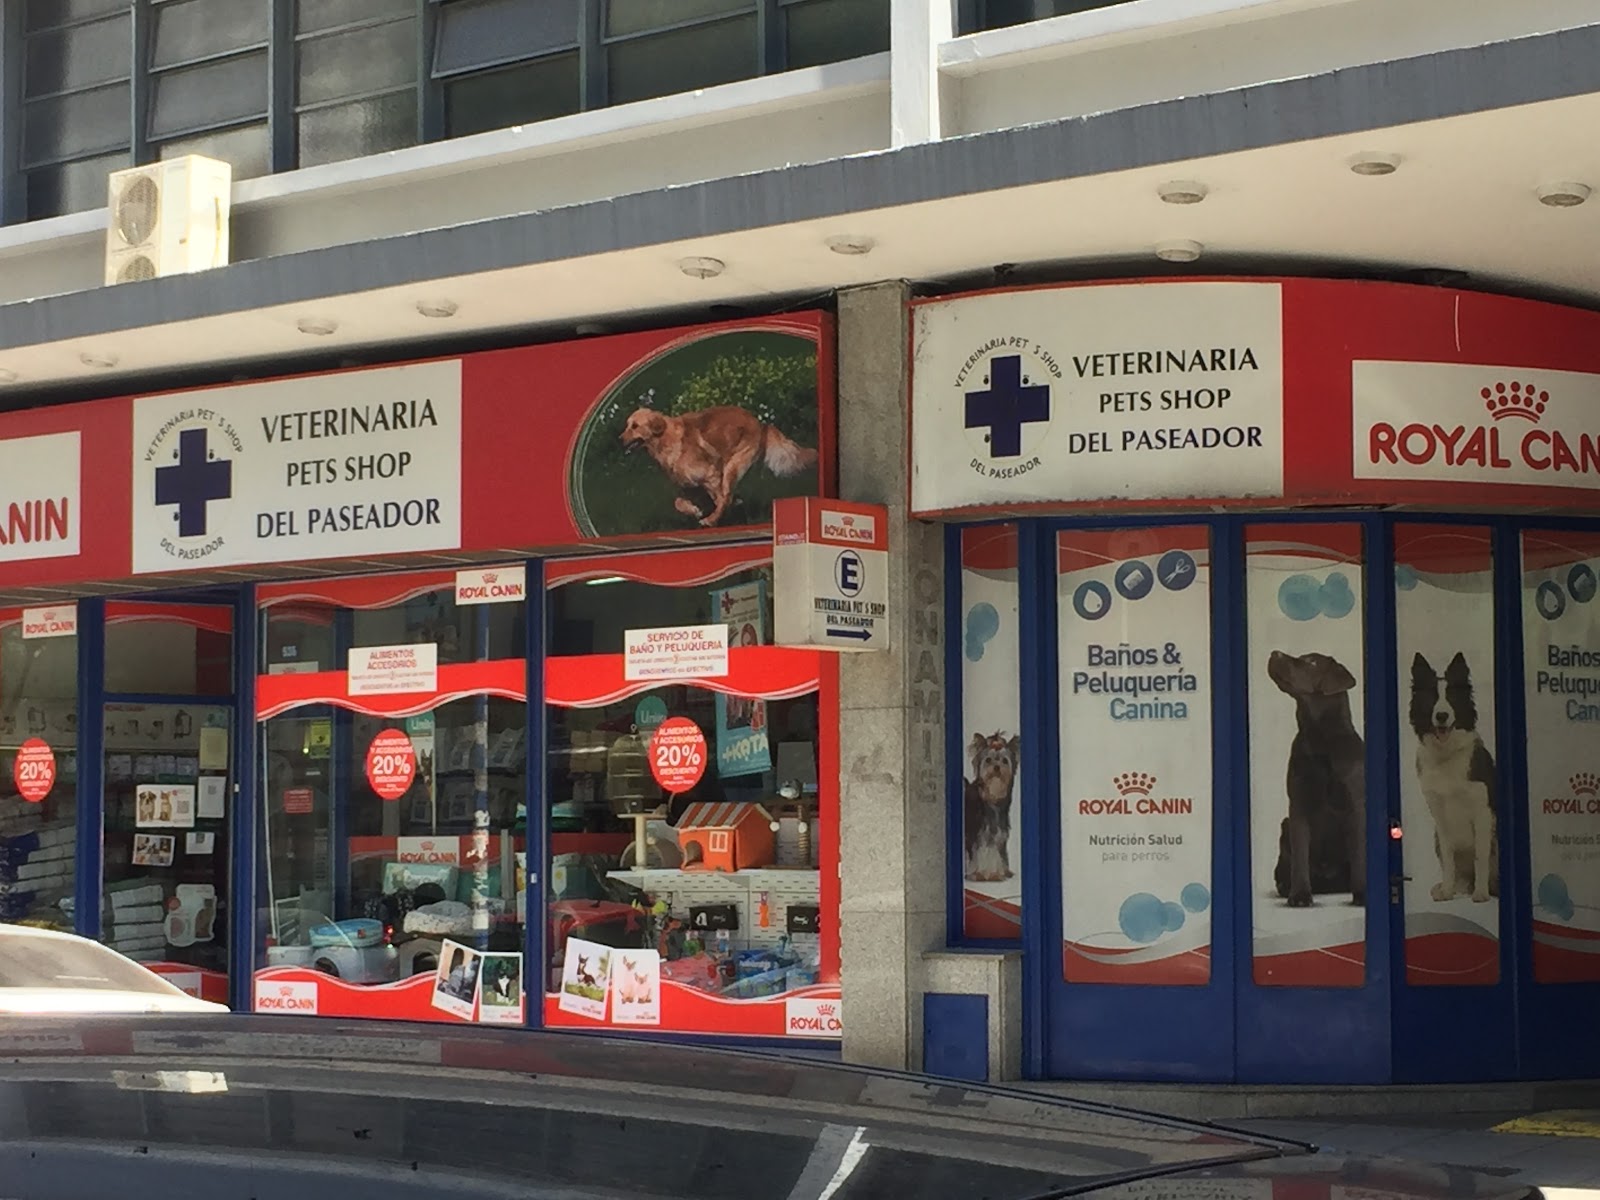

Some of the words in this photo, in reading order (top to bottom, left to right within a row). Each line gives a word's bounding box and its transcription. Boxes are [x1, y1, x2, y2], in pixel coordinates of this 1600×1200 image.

[954, 337, 1006, 388] VETERINARIA
[1009, 336, 1029, 349] PET
[1040, 351, 1062, 379] SHOP
[1073, 347, 1258, 378] VETERINARIA
[1100, 391, 1152, 413] PETS
[1160, 388, 1231, 410] SHOP
[261, 398, 438, 443] VETERINARIA
[144, 408, 195, 462] VETERINARIA
[224, 424, 244, 453] SHOP
[1069, 433, 1113, 454] DEL
[1122, 426, 1263, 451] PASEADOR
[1369, 422, 1512, 468] ROYAL
[287, 458, 337, 487] PETS
[345, 451, 411, 481] SHOP
[970, 458, 986, 476] DEL
[989, 456, 1042, 479] PASEADOR
[256, 511, 299, 538] DEL
[308, 498, 441, 534] PASEADOR
[824, 524, 848, 539] ROYAL
[160, 538, 175, 556] DEL
[178, 536, 225, 560] PASEADOR
[841, 557, 858, 590] E
[459, 585, 488, 599] ROYAL
[491, 584, 522, 597] CANIN
[814, 597, 851, 612] VETERINARIA
[629, 643, 654, 654] BAÑO
[664, 641, 723, 652] PELUQUERIA
[647, 631, 689, 643] SERVICIO
[691, 630, 704, 640] DE
[367, 658, 417, 670] ACCESORIOS
[370, 649, 415, 660] ALIMENTOS
[1087, 642, 1158, 667] Baños
[1162, 643, 1181, 665] &
[1073, 667, 1198, 698] Peluquería
[1537, 671, 1600, 699] Peluqu
[1110, 697, 1188, 720] Canina
[372, 755, 411, 775] 20%
[656, 745, 700, 767] 20%
[20, 762, 52, 780] 20%
[1079, 799, 1132, 815] ROYAL
[1136, 798, 1192, 814] CANIN
[1543, 799, 1584, 814] ROYAL
[1089, 833, 1145, 846] Nutrición
[1148, 834, 1183, 846] Salud
[1101, 852, 1128, 863] para
[1131, 852, 1170, 863] perros
[259, 998, 284, 1009] ROYAL
[287, 998, 314, 1009] CANIN
[790, 1017, 825, 1030] ROYAL
